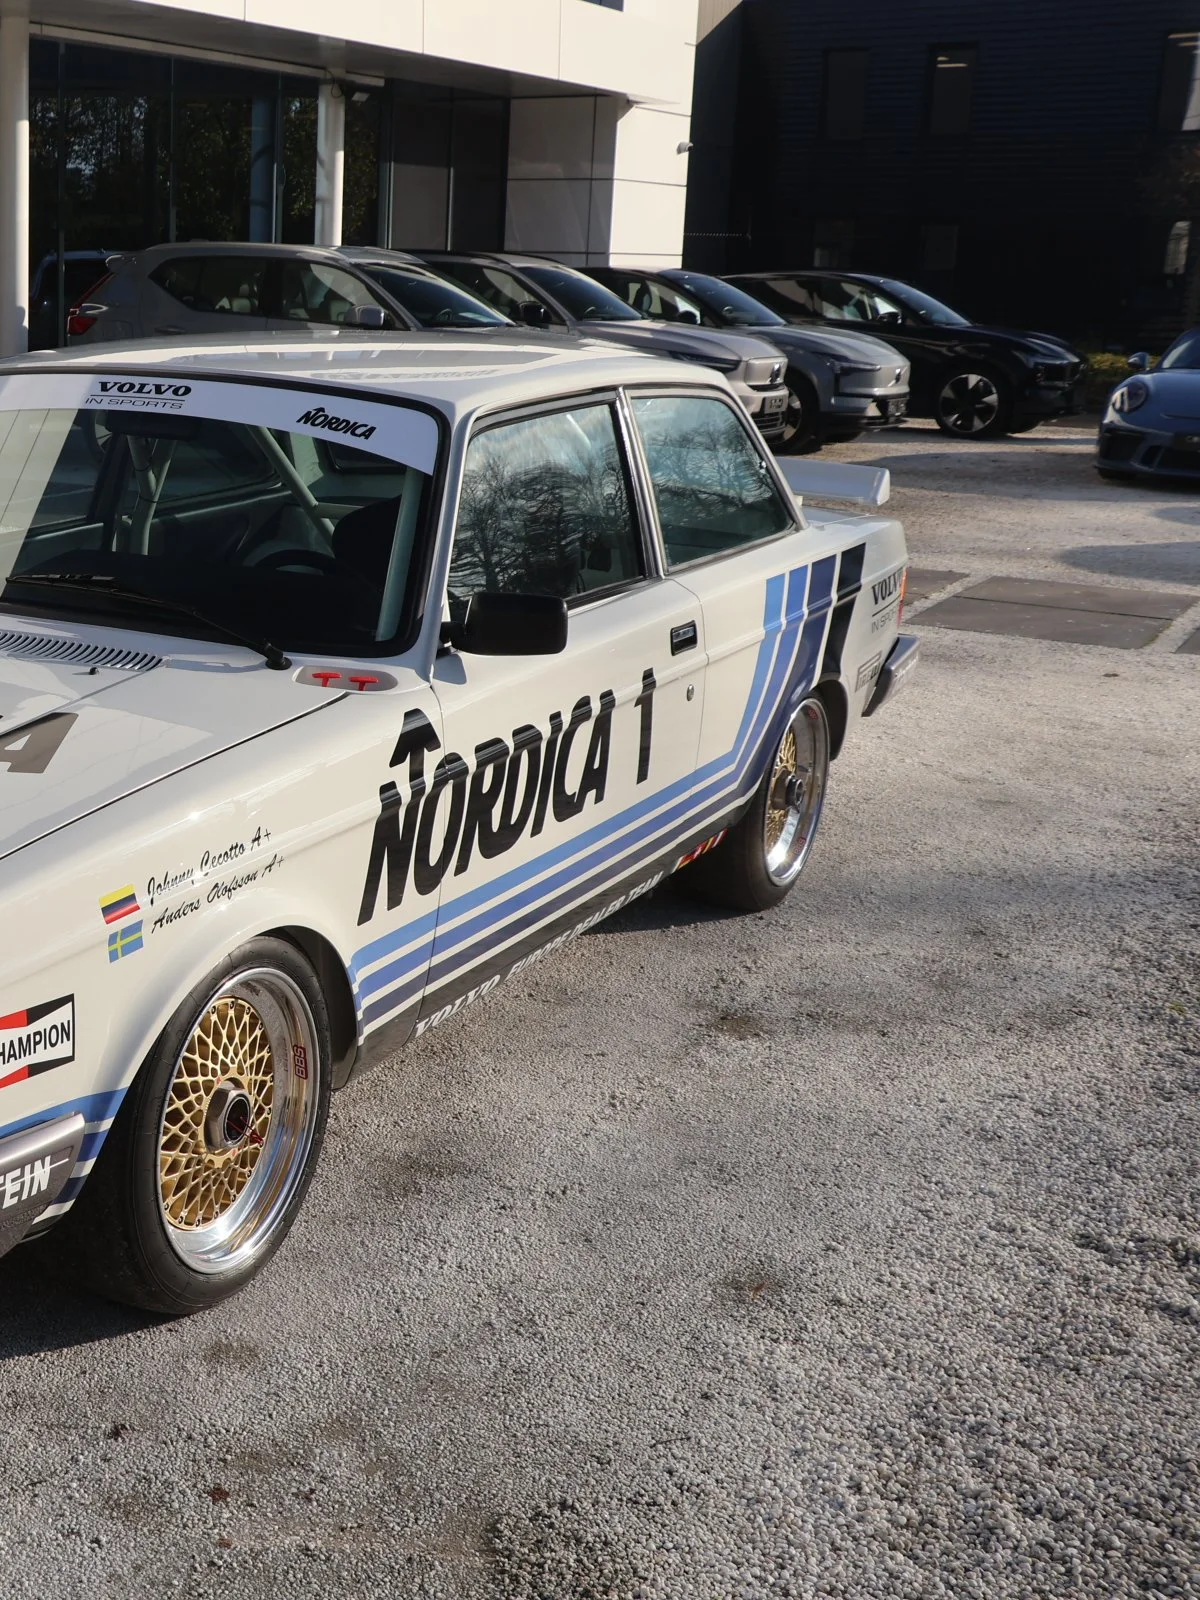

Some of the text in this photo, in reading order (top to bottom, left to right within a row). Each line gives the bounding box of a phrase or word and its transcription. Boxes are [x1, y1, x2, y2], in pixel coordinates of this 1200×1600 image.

[85, 397, 183, 409] IN SPORTS
[98, 381, 192, 397] VOLVO
[296, 407, 377, 440] NORDICA
[357, 689, 615, 926] NORDICA
[151, 897, 201, 934] Anders
[206, 870, 259, 903] Olofsson
[415, 871, 665, 1038] VOLVO EUROPE DEALER TEAM
